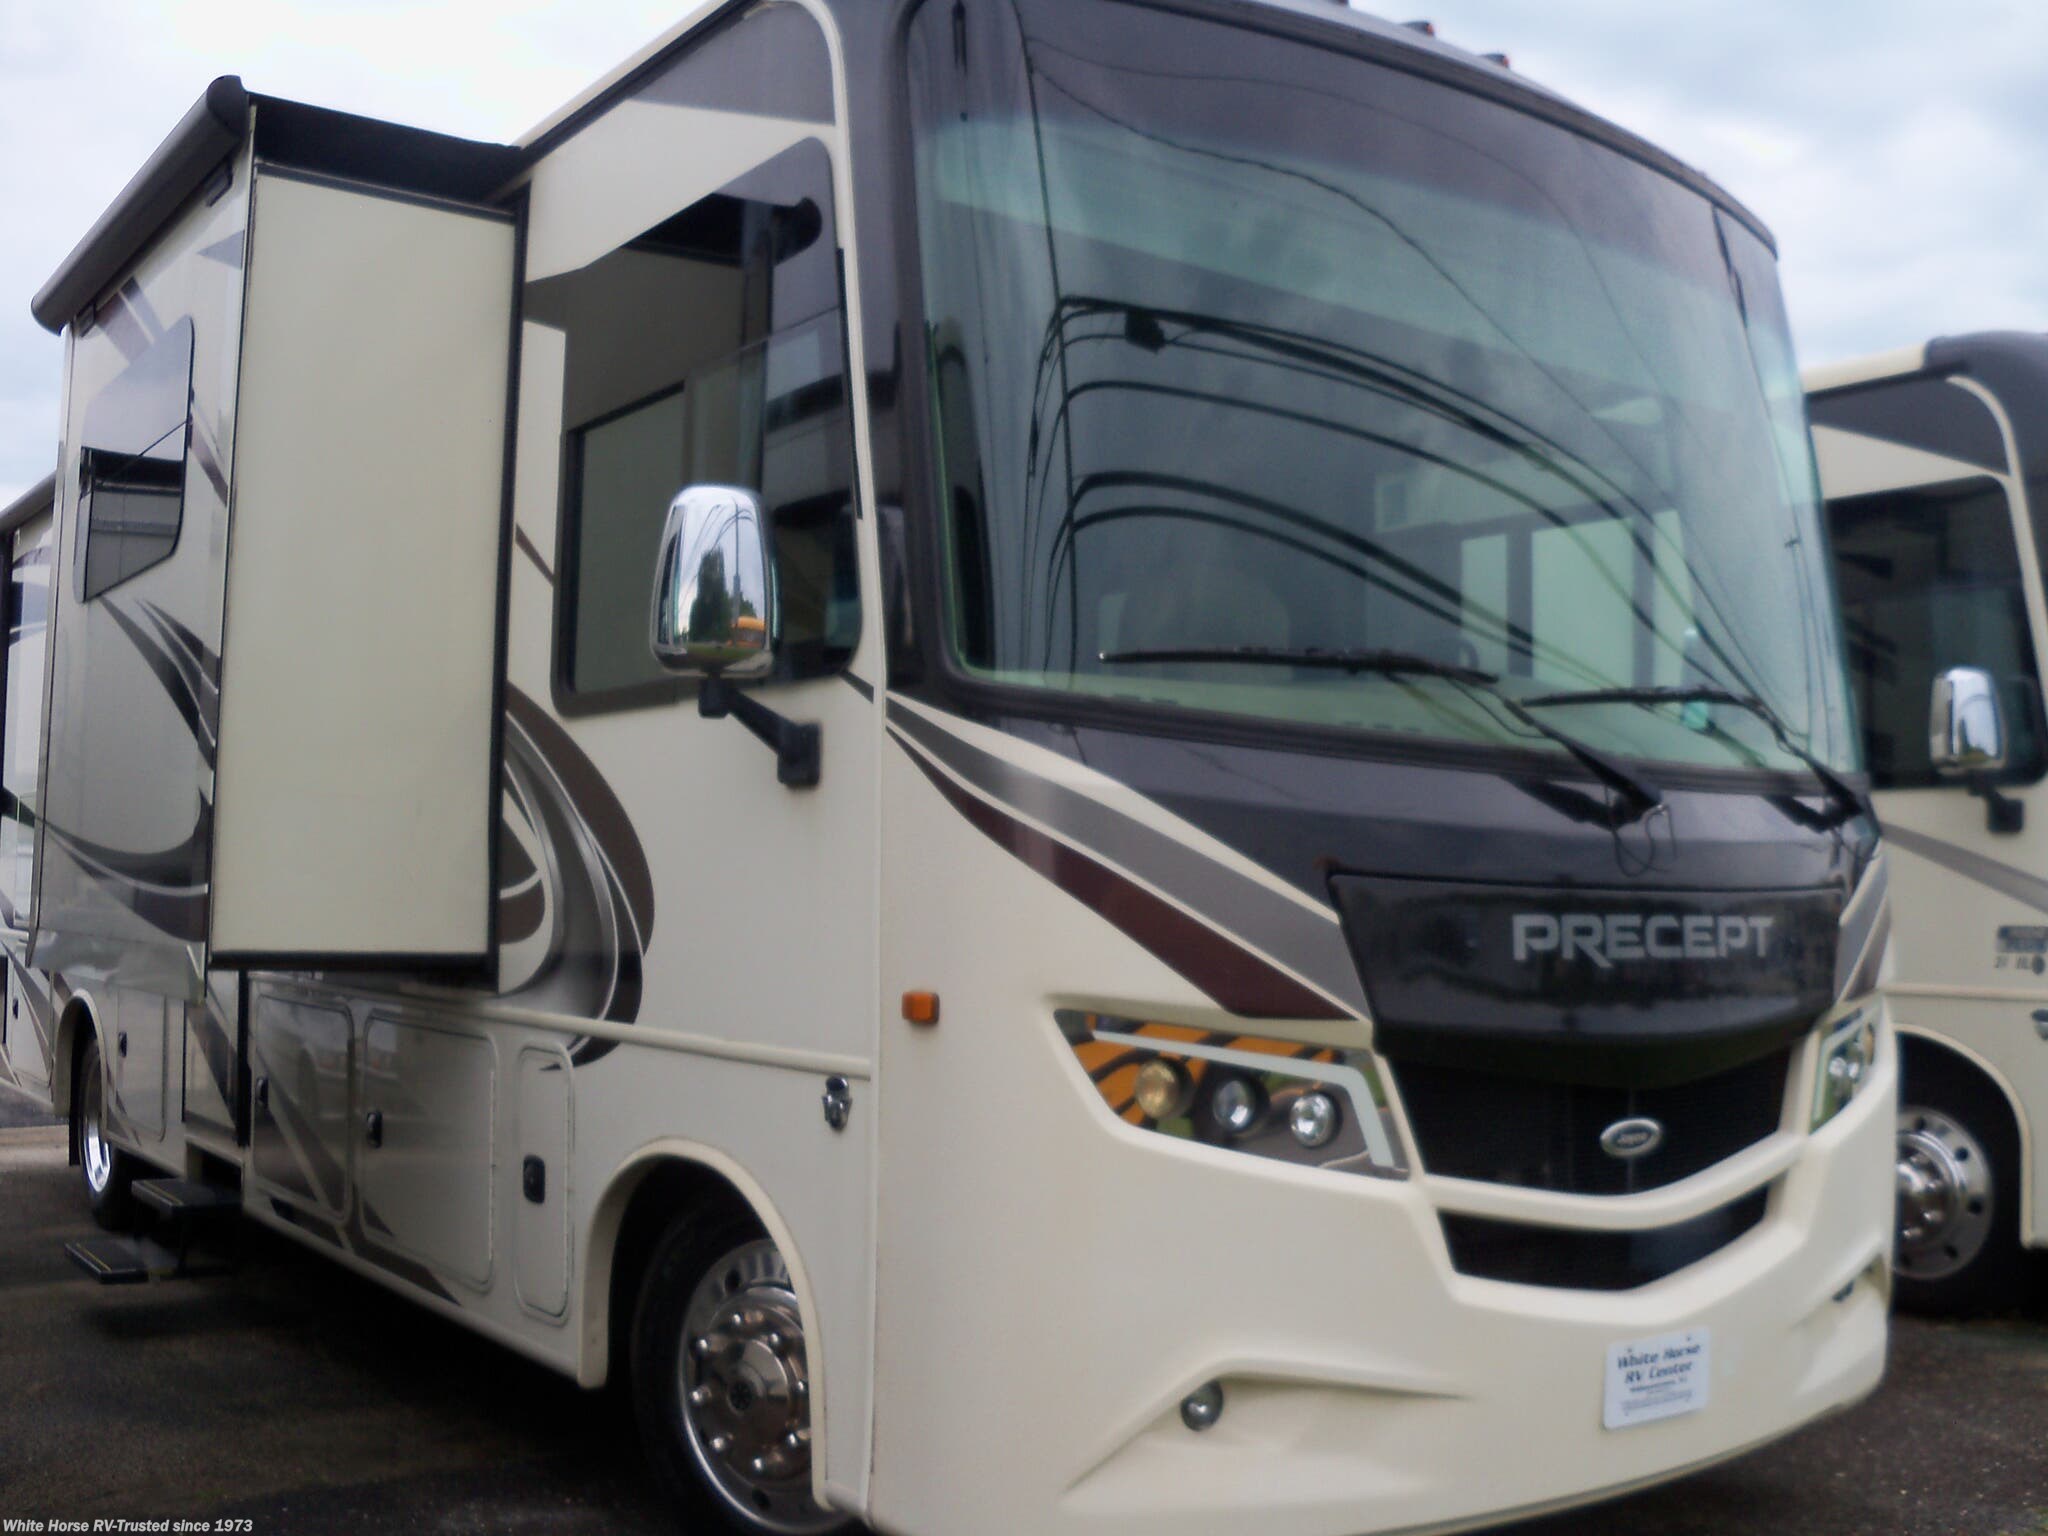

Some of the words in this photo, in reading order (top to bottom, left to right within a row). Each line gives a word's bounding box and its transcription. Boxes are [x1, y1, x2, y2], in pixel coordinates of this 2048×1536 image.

[1512, 914, 1773, 968] PRECEPT
[1617, 1352, 1659, 1369] White
[1624, 1369, 1643, 1384] RV
